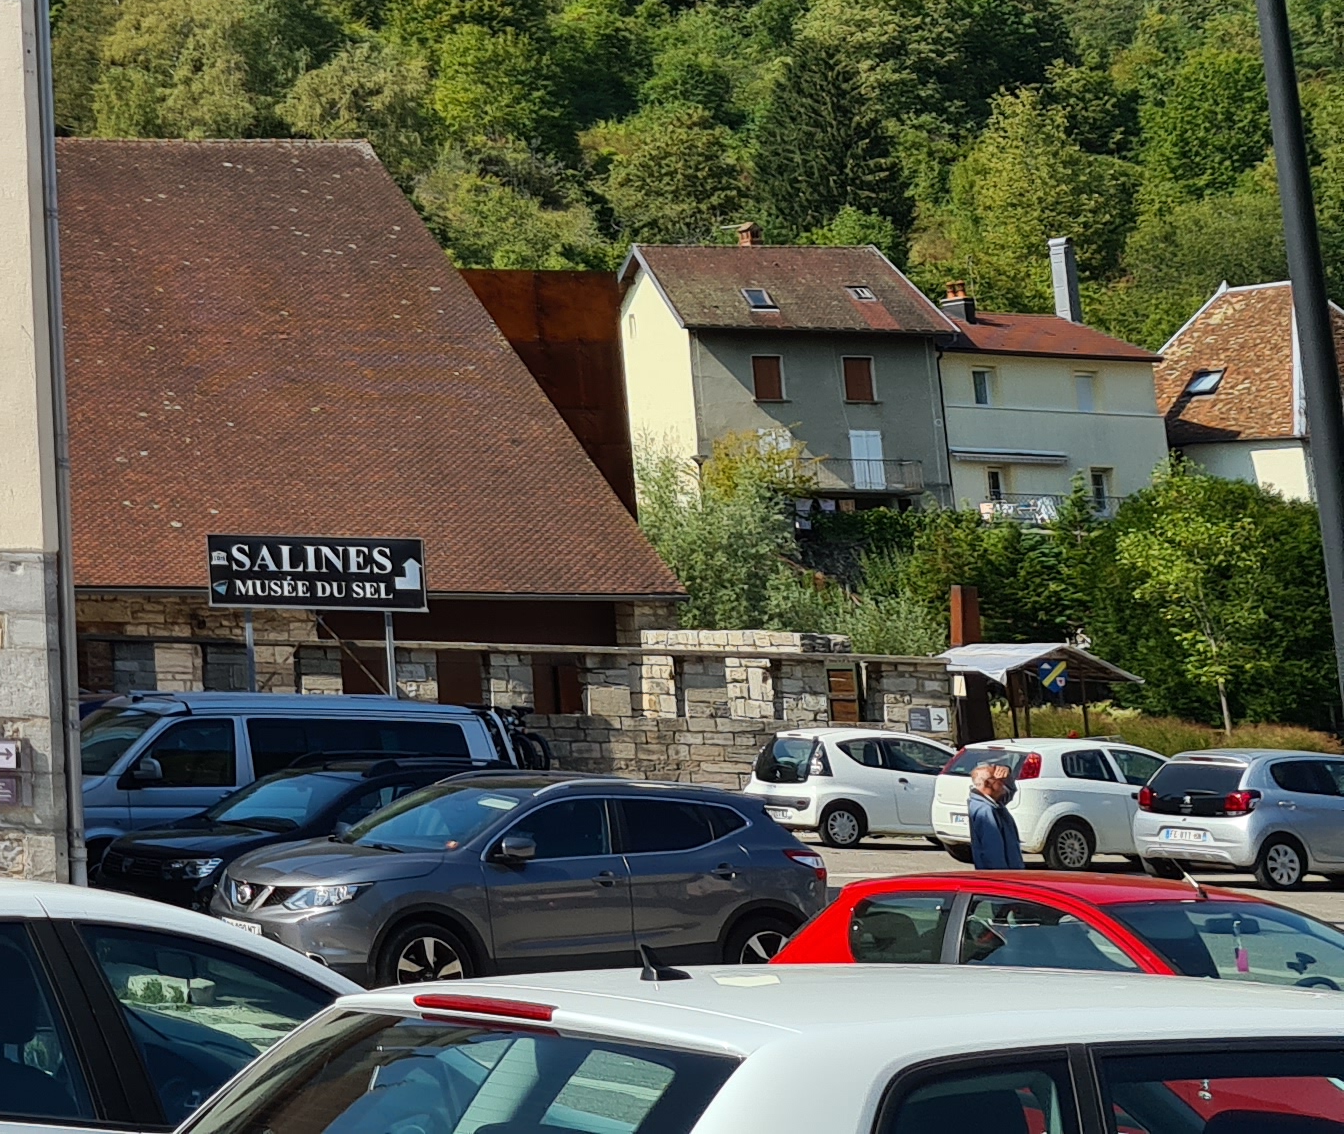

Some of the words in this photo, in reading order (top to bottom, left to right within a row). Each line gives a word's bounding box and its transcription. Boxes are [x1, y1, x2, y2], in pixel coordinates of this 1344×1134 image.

[231, 543, 393, 574] SALINES
[234, 575, 310, 597] MUSÉE
[315, 580, 346, 598] DU
[352, 581, 394, 599] SEL
